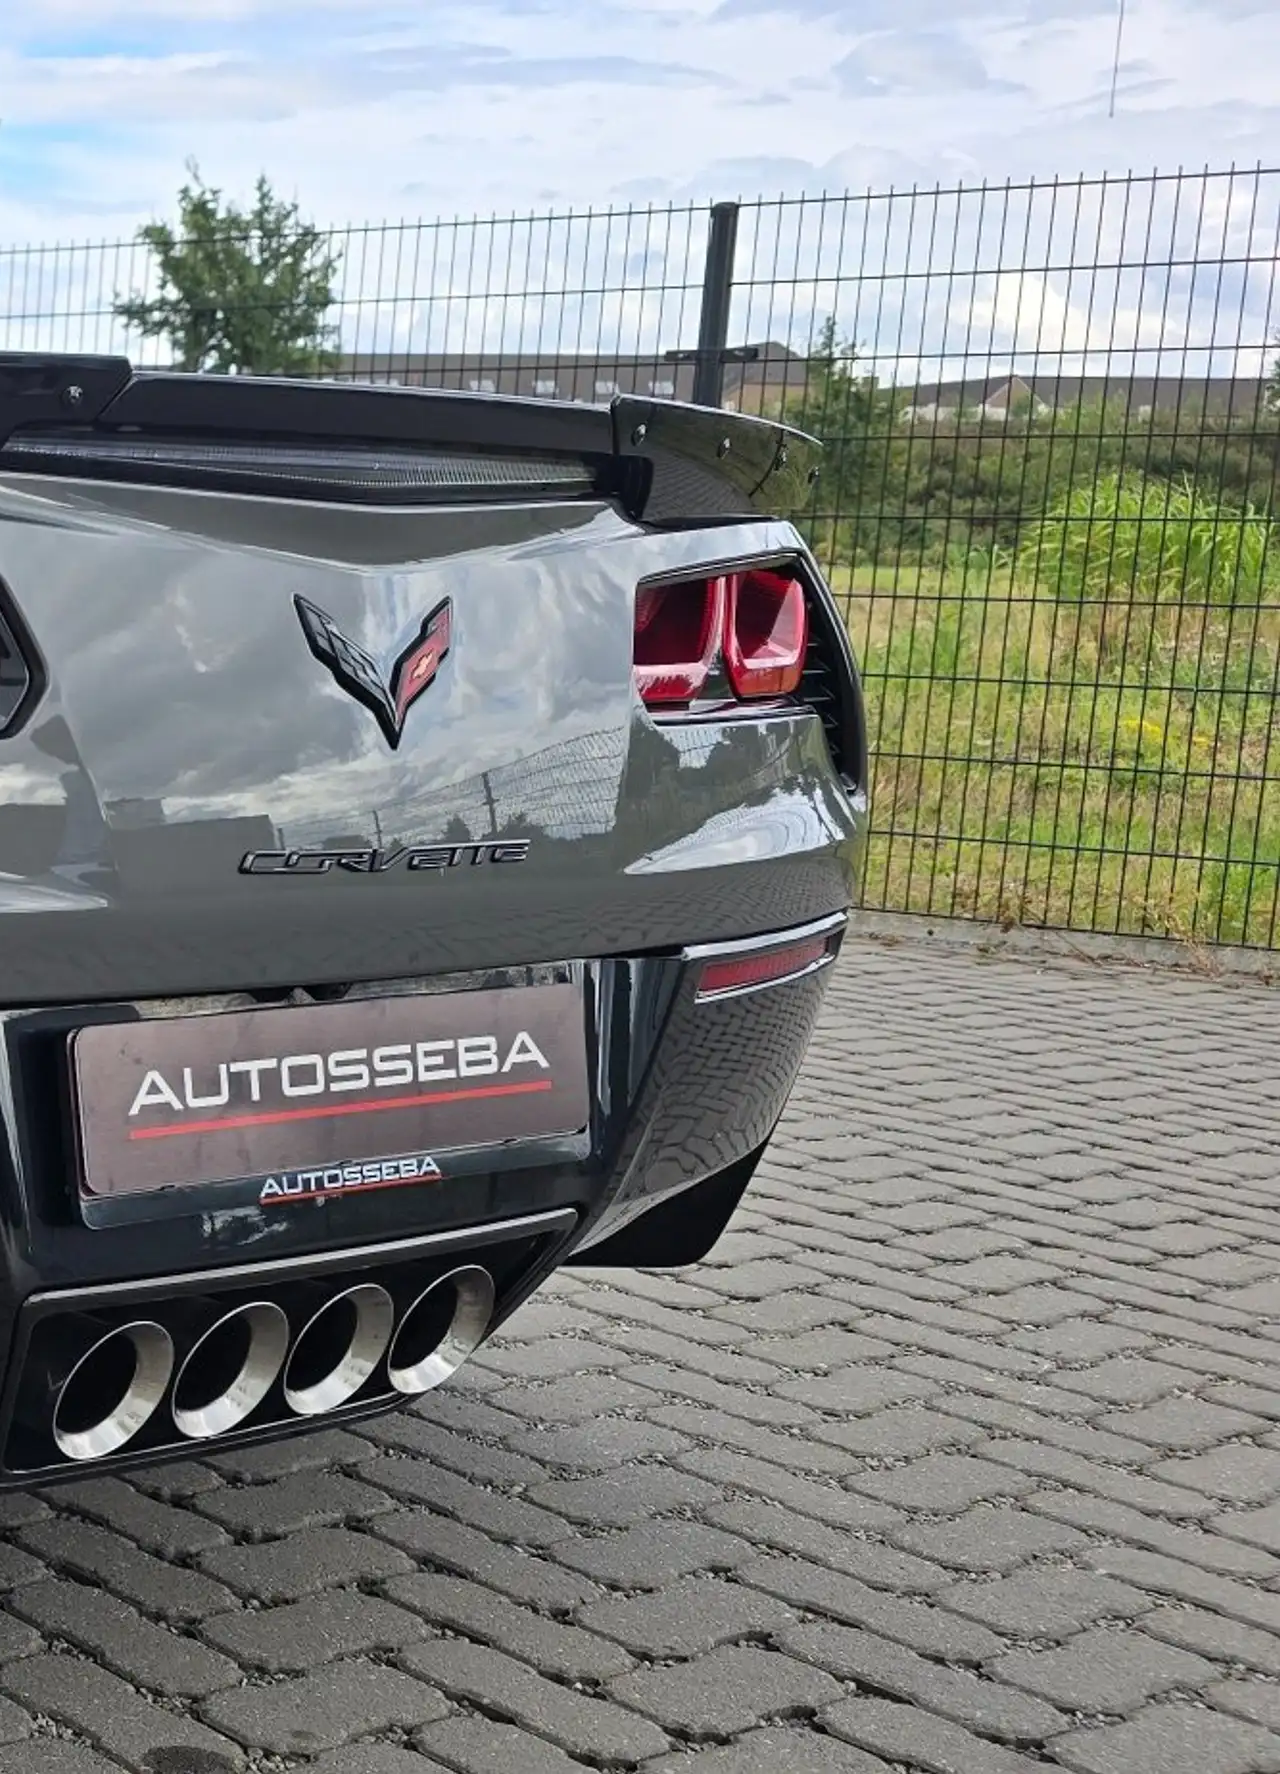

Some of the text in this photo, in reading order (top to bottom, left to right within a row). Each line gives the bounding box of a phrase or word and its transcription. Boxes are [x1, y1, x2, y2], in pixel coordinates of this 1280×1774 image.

[238, 838, 532, 875] CORVETTE
[127, 1030, 550, 1116] AUTOSSEBA
[259, 1155, 441, 1199] AUTOSSEBA
